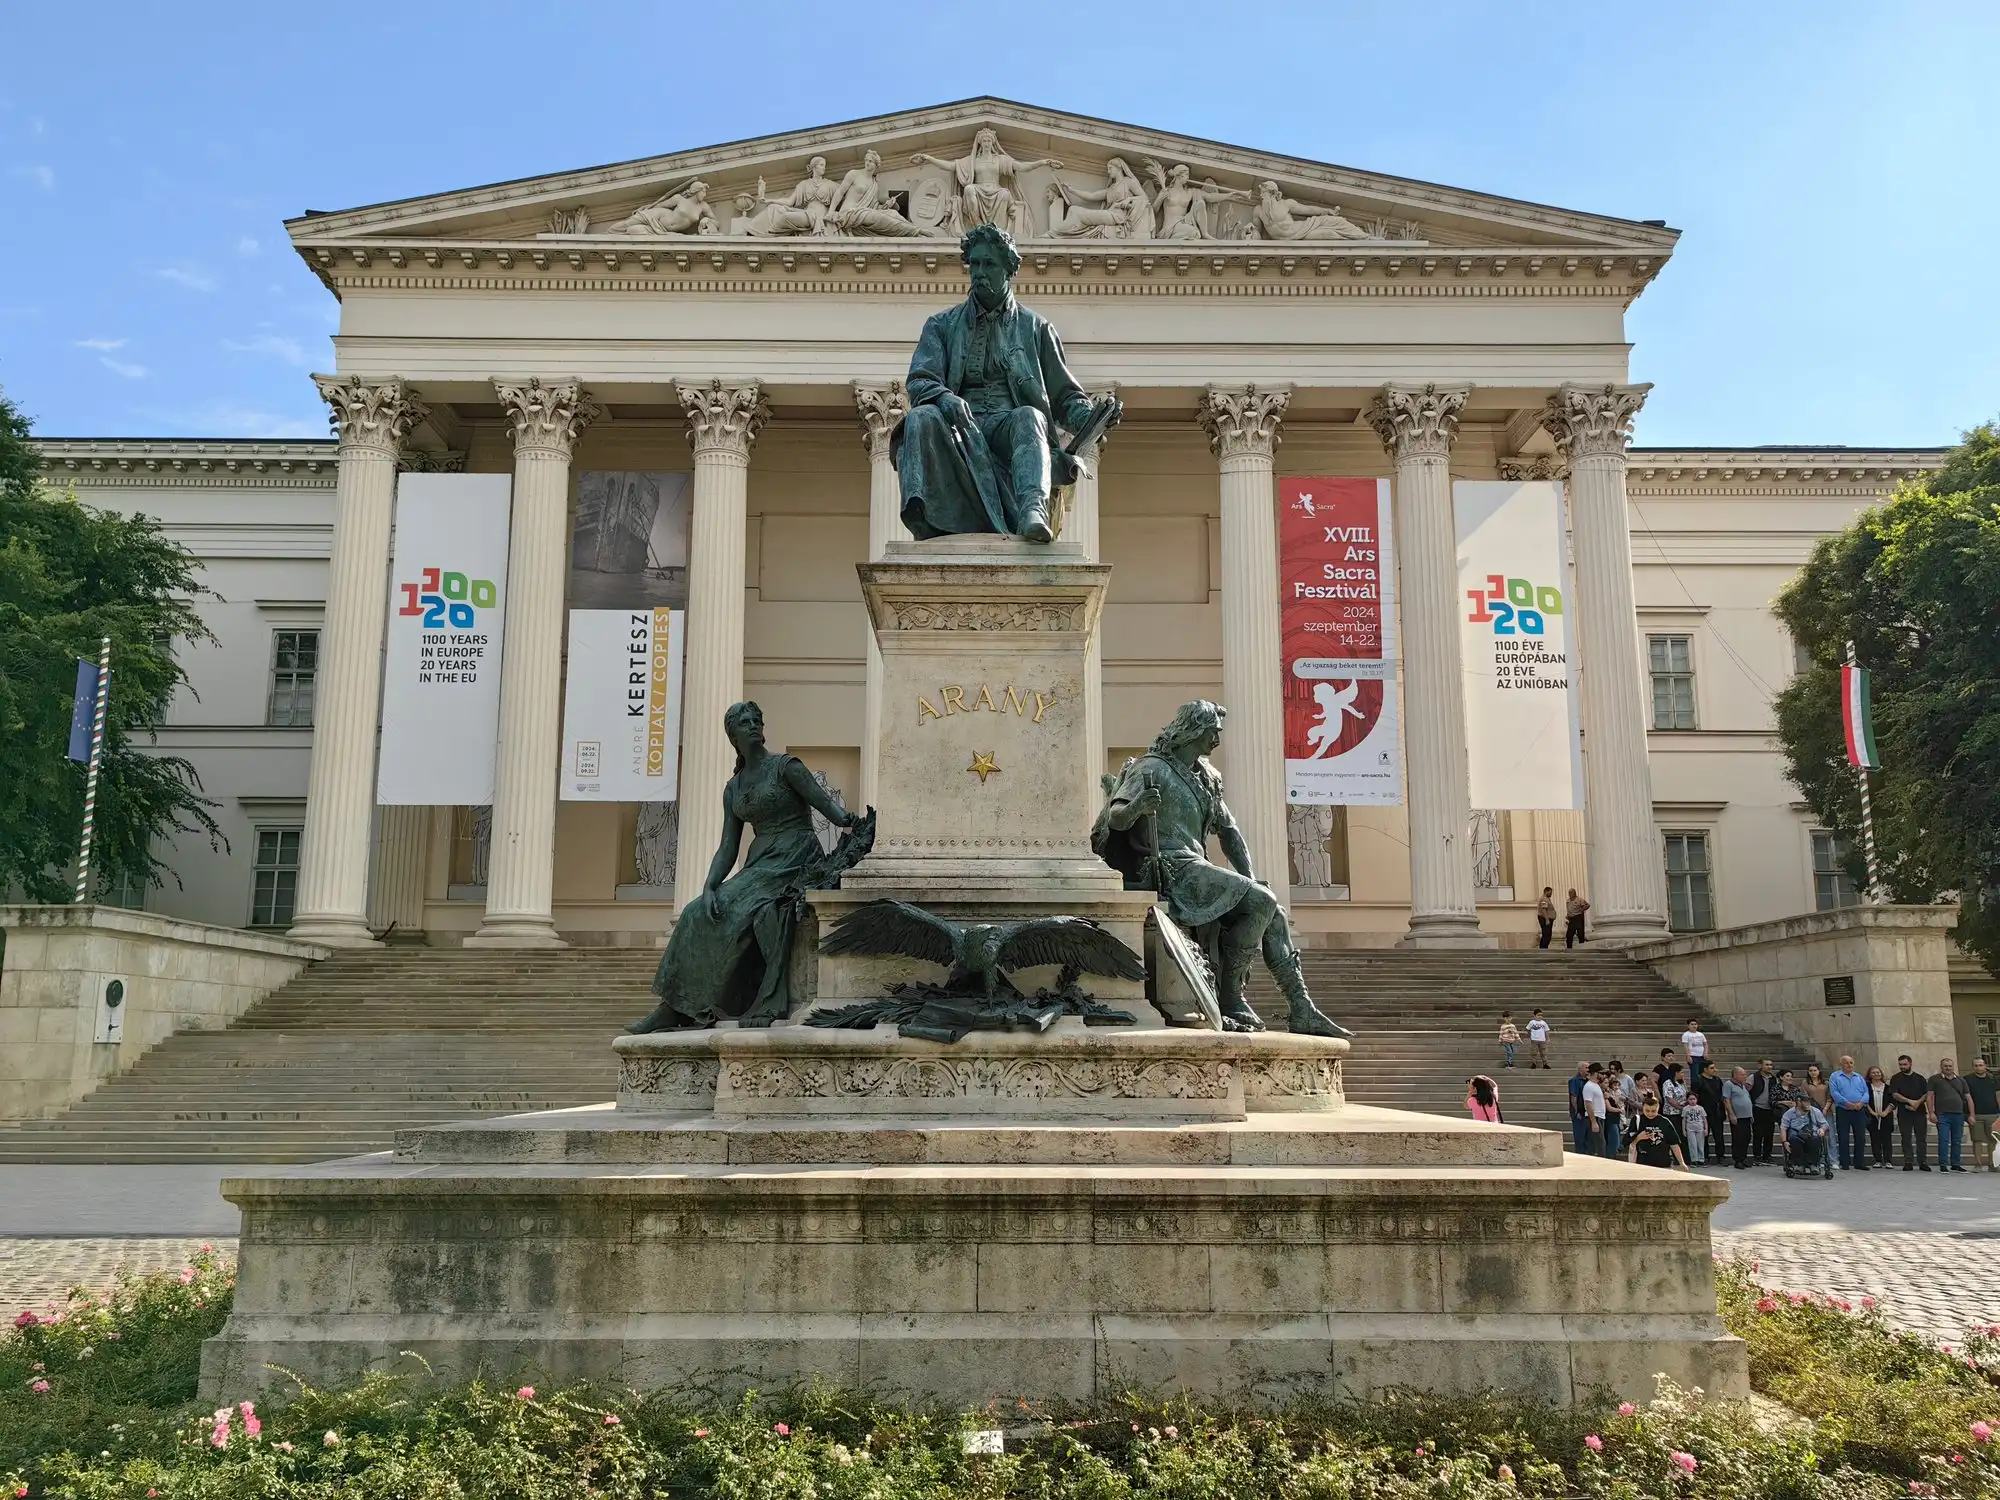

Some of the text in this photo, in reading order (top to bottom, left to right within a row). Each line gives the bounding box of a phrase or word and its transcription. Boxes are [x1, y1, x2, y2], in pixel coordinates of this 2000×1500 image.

[1324, 527, 1375, 543] XVIII.
[1344, 546, 1376, 562] Ars
[1323, 564, 1376, 580] Sacra
[1294, 582, 1377, 599] Fesztivál
[420, 595, 474, 628] 20
[1343, 607, 1377, 618] 2024.
[1488, 602, 1544, 634] 20
[1304, 621, 1377, 633] szeptember
[422, 635, 488, 645] 1100 YEARS
[1340, 634, 1378, 646] 14-22.
[1495, 639, 1544, 651] 1100 ÉVE
[421, 648, 484, 658] IN EUROPE
[653, 614, 668, 682] COPIES
[1495, 652, 1566, 664] EURÓPÁBAN
[420, 660, 476, 670] 20 YEARS
[627, 614, 648, 716] KERTÉSZ
[1496, 664, 1535, 676] 20 ÉVE
[420, 673, 477, 683] IN THE EU
[1497, 677, 1568, 689] AZ UNIÓBAN
[918, 684, 1058, 726] ARANY
